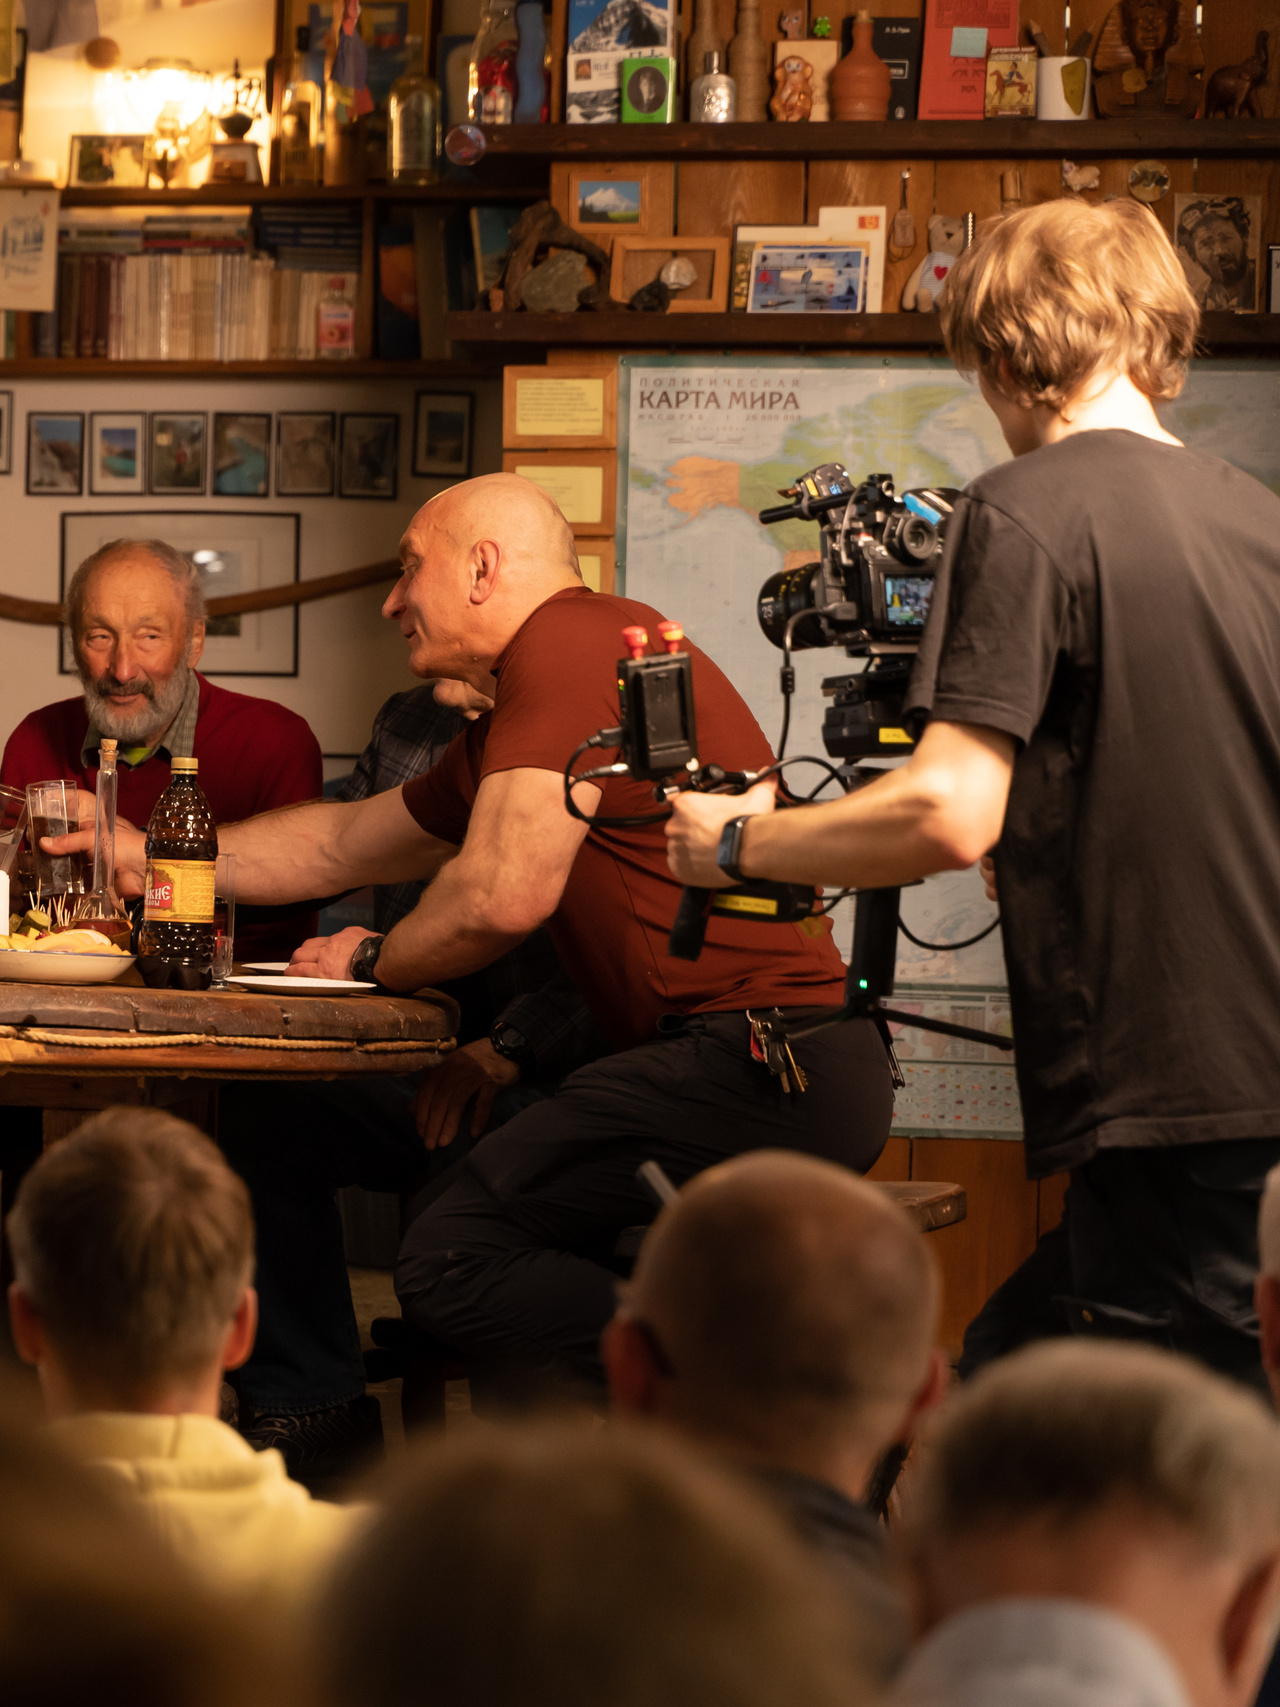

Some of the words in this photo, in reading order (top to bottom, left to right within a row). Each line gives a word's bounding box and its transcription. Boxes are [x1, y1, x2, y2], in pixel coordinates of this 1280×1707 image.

[639, 377, 800, 388] ПОЛИТИЧЕСКАЯ
[638, 390, 720, 410] КАРТА
[727, 390, 800, 410] МИРА
[637, 413, 704, 421] МАСШТАБ
